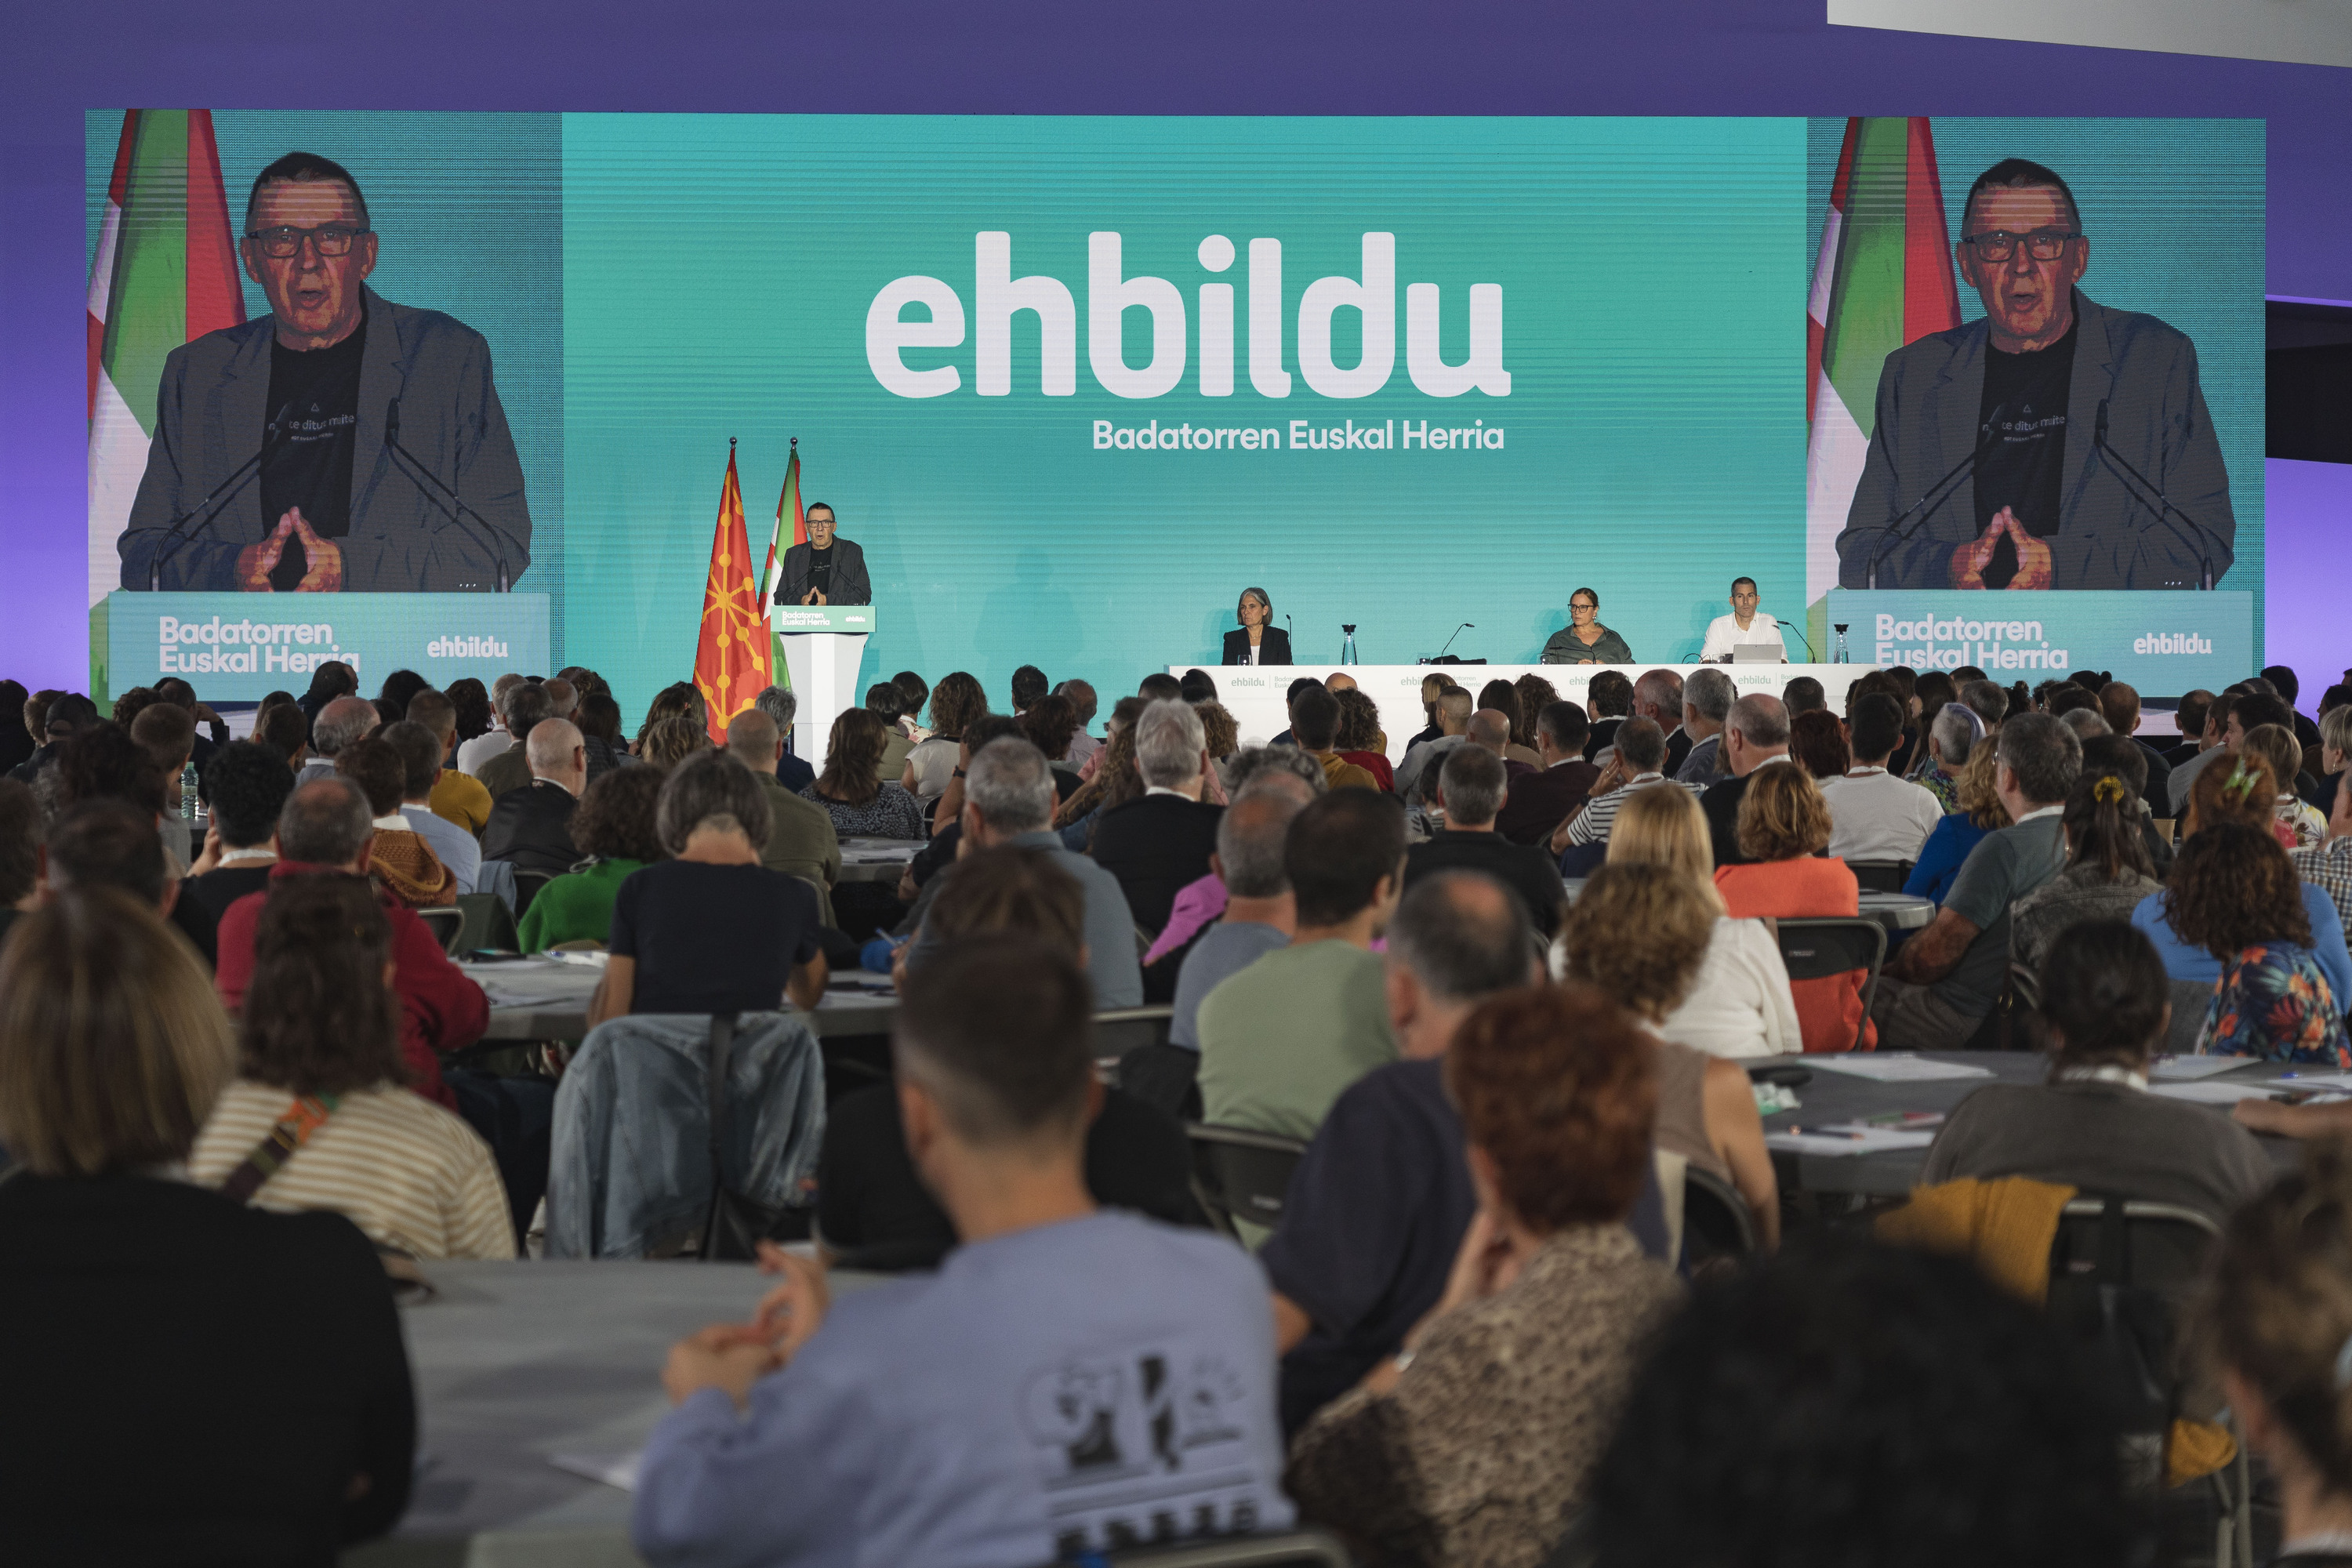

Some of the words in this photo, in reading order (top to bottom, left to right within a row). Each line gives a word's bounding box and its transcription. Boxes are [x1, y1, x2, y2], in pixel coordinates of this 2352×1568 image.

[865, 230, 1512, 399] ehbildu
[1093, 419, 1280, 450] Badatorren
[1290, 419, 1394, 450] Euskal
[1403, 419, 1504, 450] Herria
[159, 615, 332, 644] Badatorren
[1876, 613, 2042, 641] Badatorren
[426, 635, 509, 658] ehbildu
[1875, 641, 1969, 669] Euskal
[1977, 641, 2069, 669] Herria
[2133, 632, 2212, 655] ehbildu
[159, 644, 257, 673] Euskal
[1231, 677, 1265, 687] ehbildu
[1737, 675, 1771, 684] ehbildu
